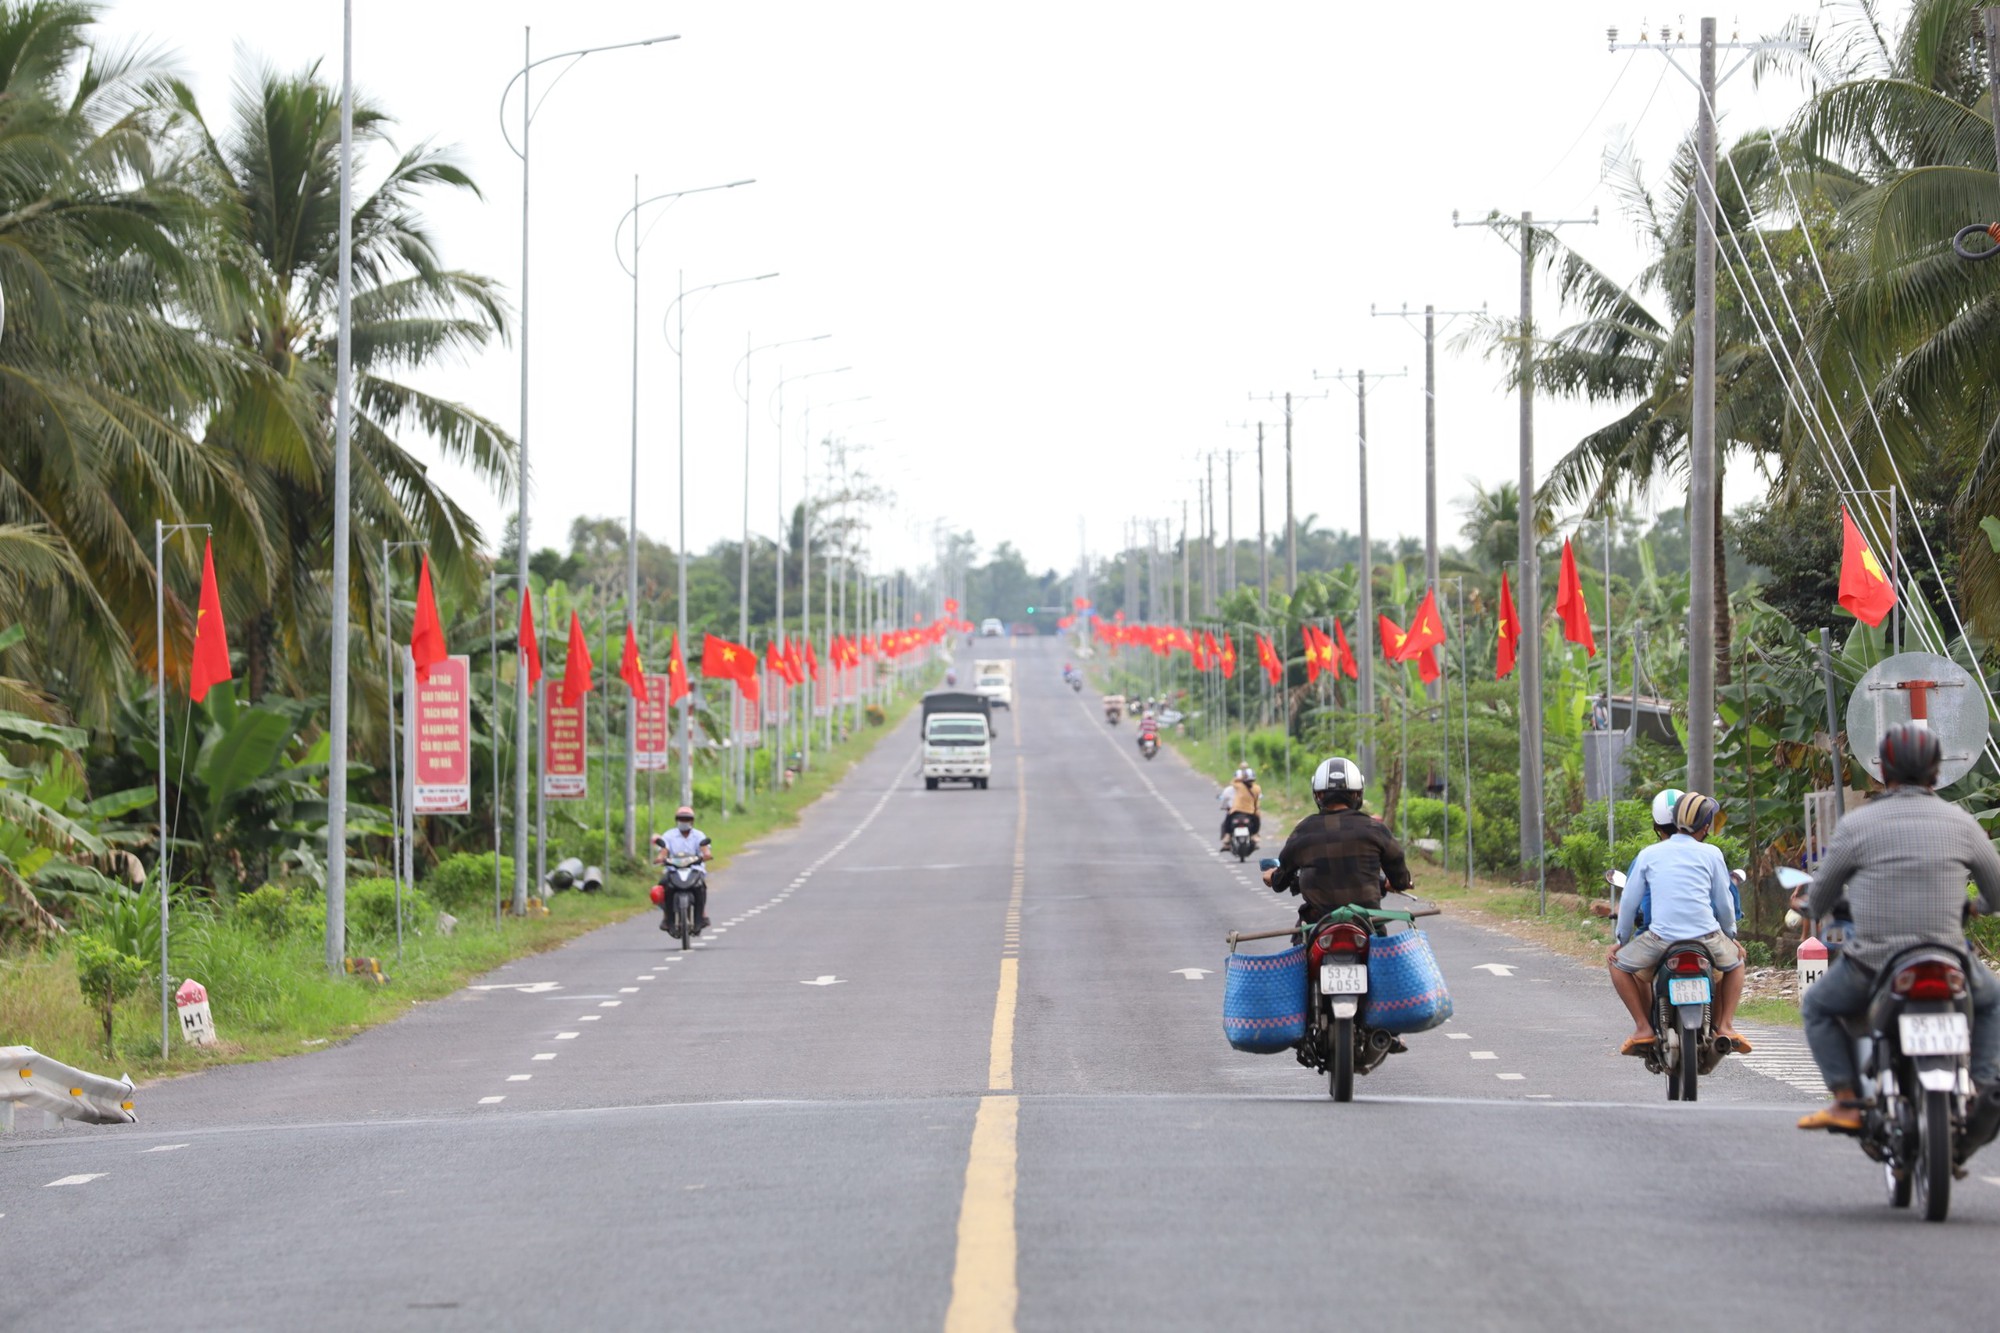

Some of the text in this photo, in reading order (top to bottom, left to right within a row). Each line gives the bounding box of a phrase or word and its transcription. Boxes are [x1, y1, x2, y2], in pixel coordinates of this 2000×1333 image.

[1328, 966, 1358, 979] 53-Z1
[1328, 980, 1360, 992] 4055
[184, 1012, 203, 1029] H1
